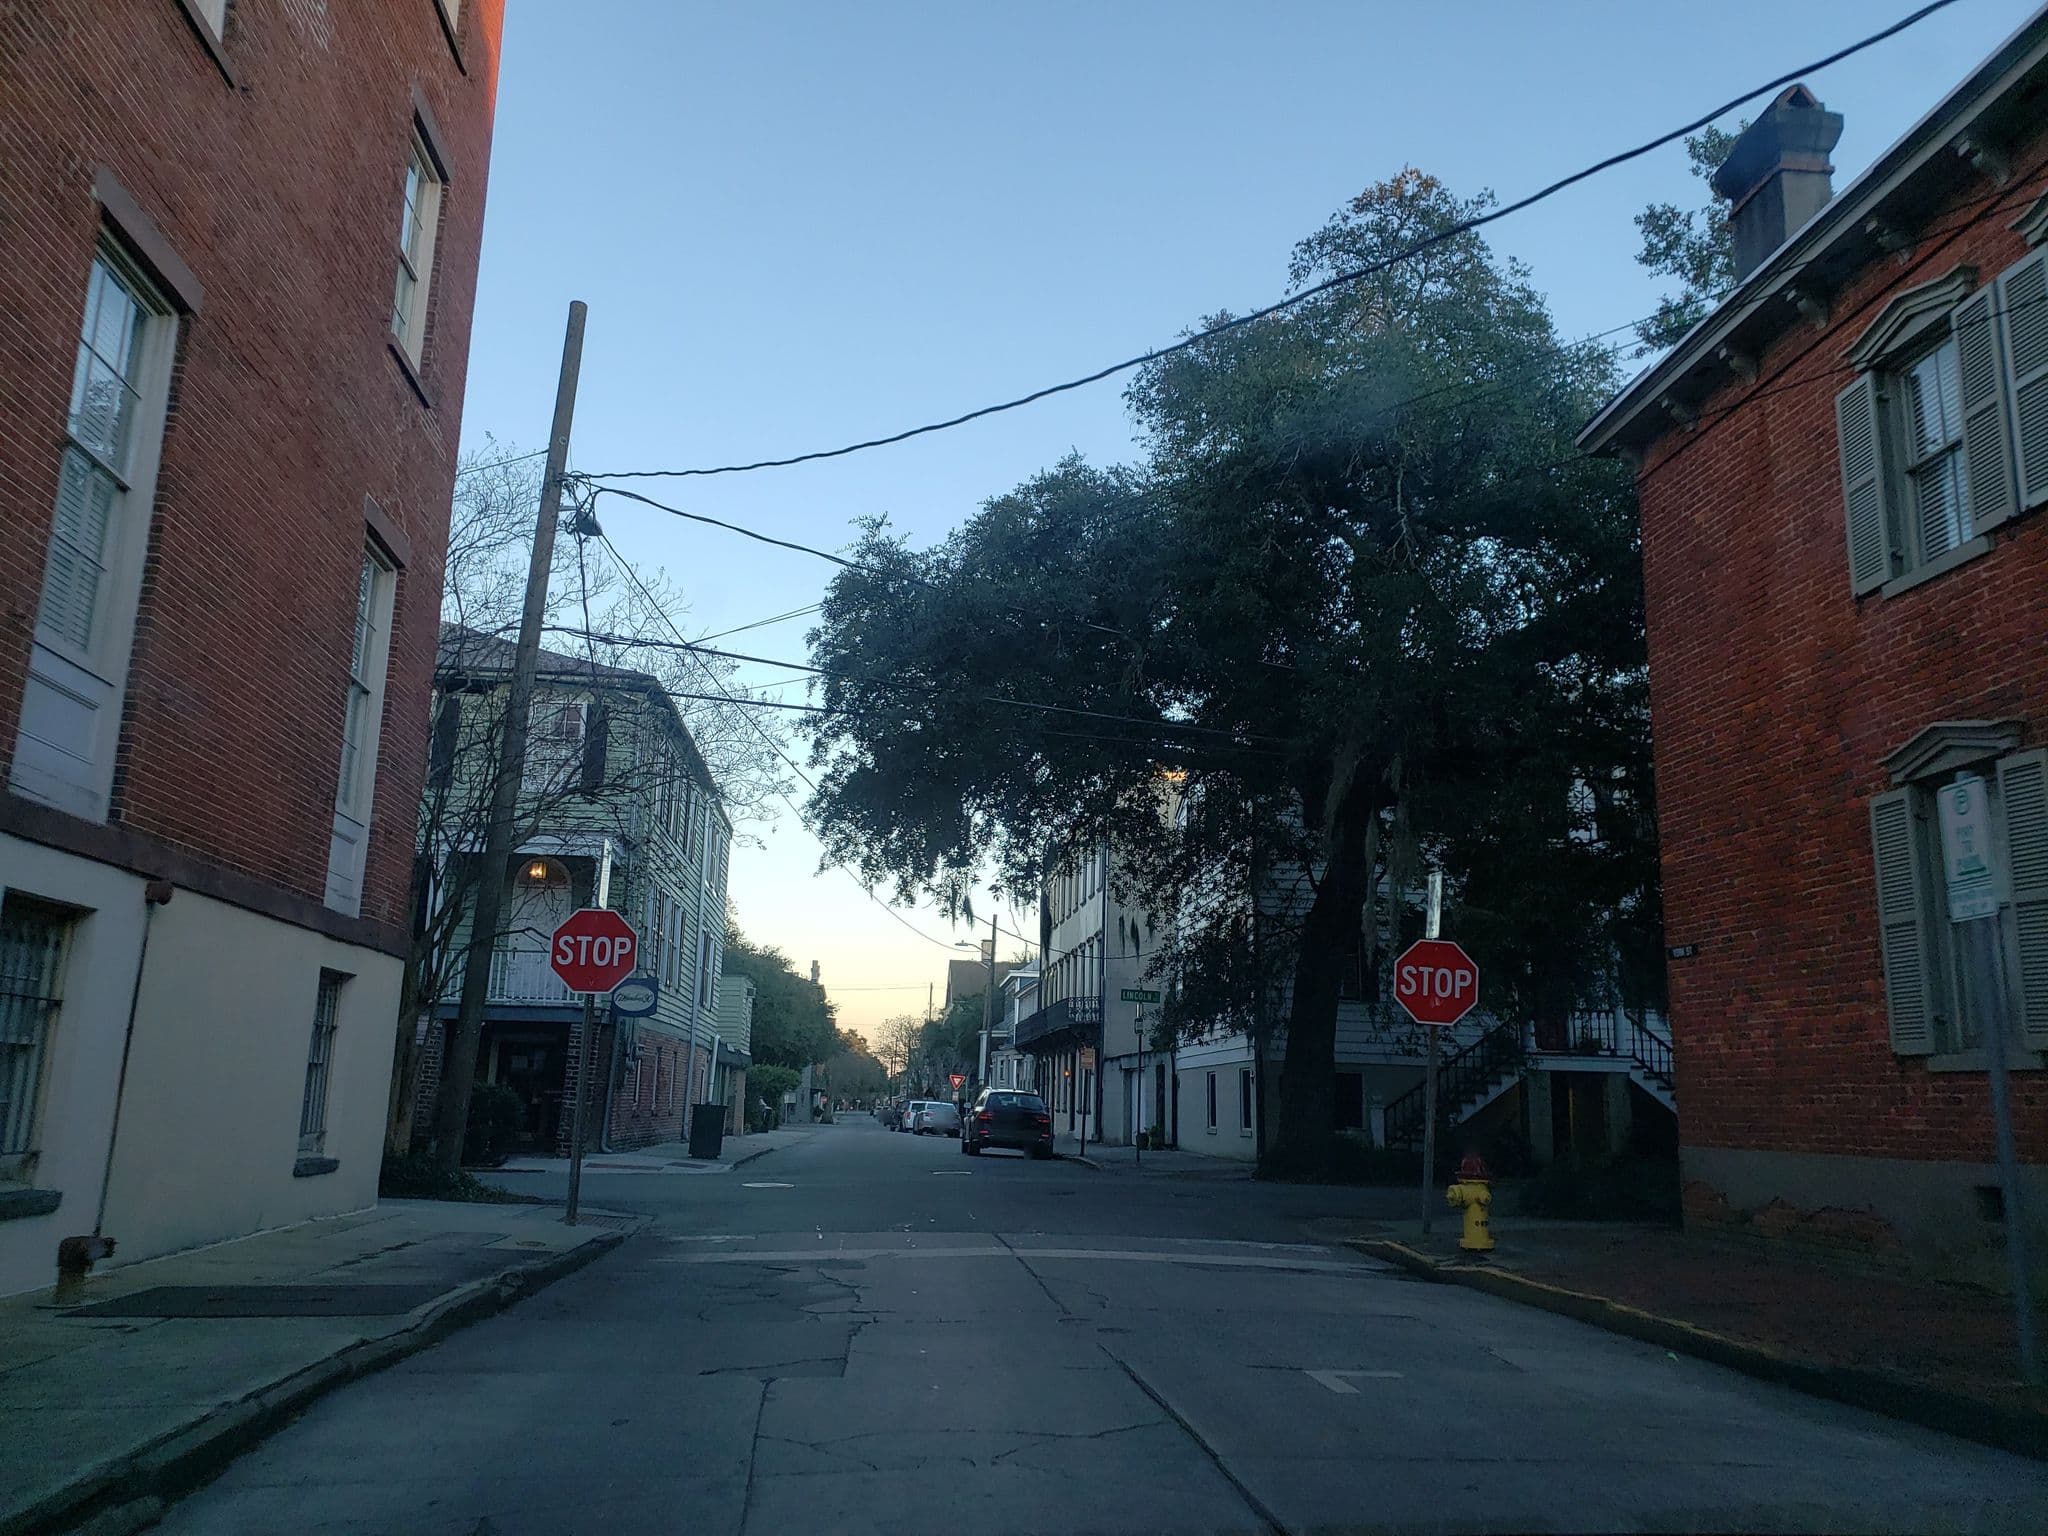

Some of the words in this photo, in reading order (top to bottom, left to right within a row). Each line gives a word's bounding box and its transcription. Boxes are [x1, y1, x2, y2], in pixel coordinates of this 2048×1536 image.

[556, 935, 631, 967] STOP
[1122, 990, 1152, 1001] LINCOLN
[1400, 965, 1472, 999] STOP
